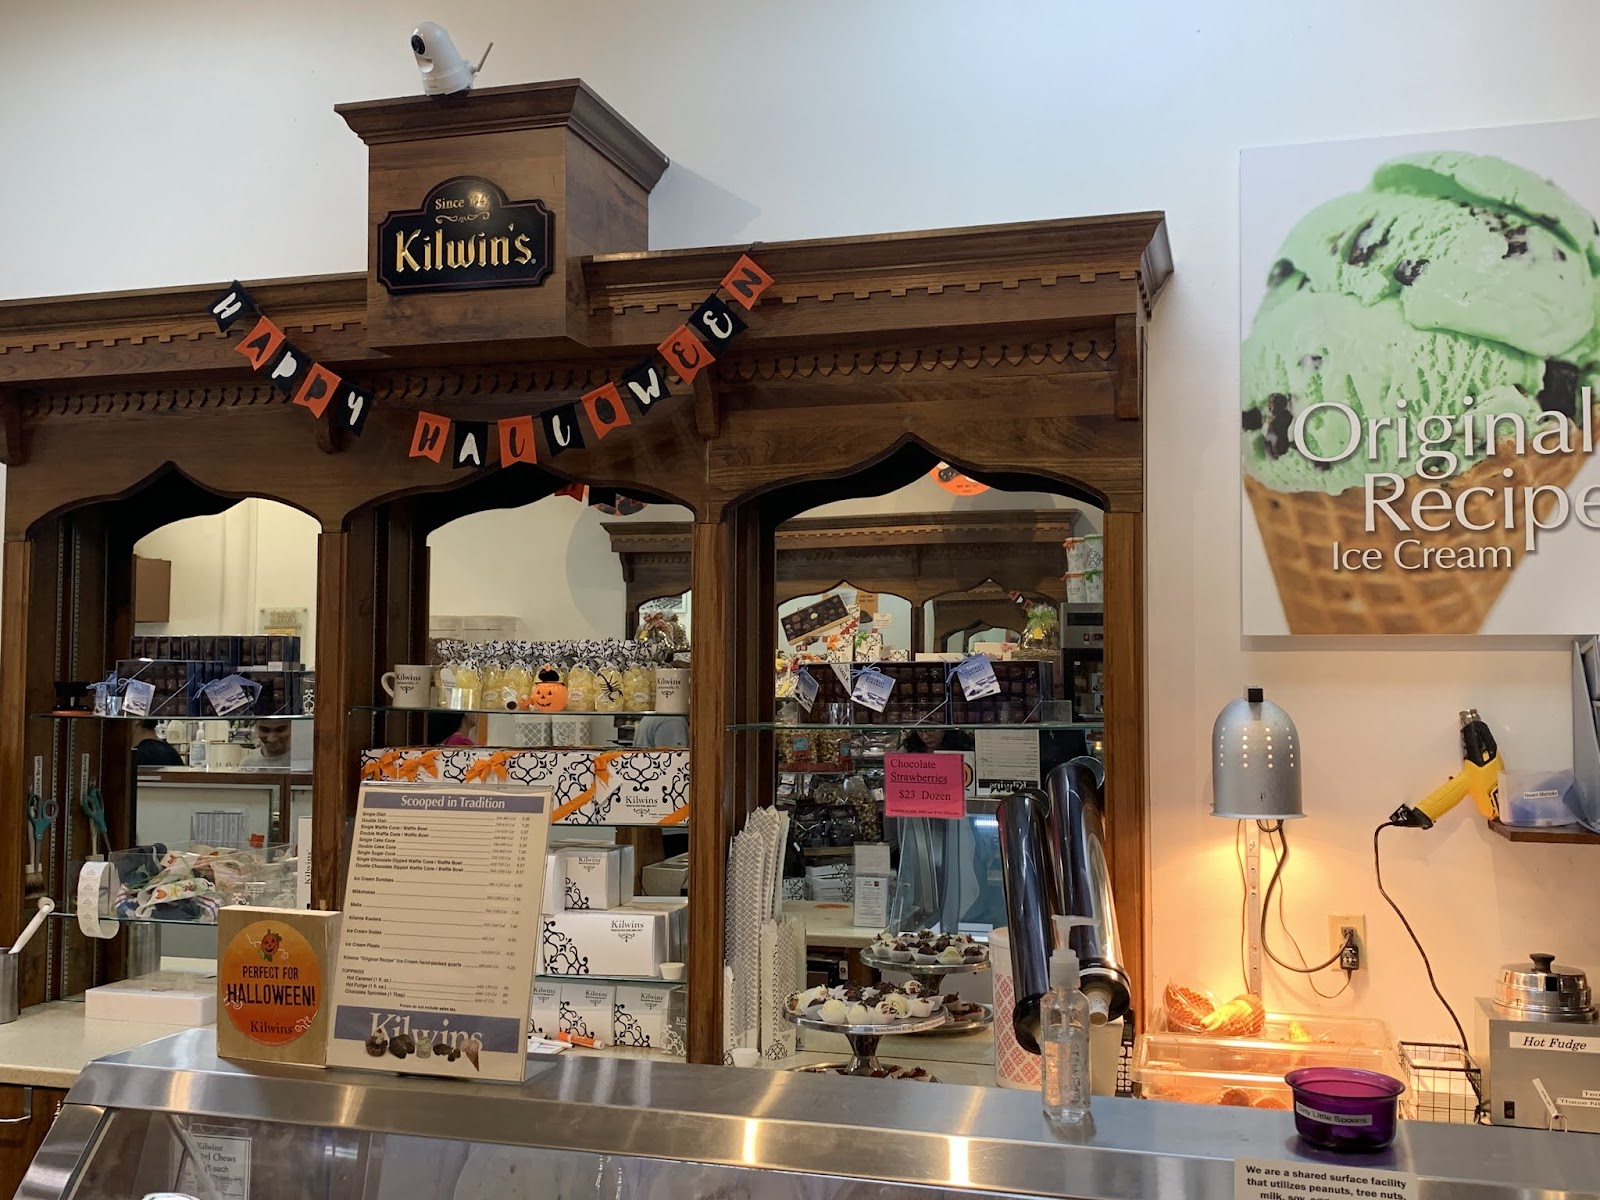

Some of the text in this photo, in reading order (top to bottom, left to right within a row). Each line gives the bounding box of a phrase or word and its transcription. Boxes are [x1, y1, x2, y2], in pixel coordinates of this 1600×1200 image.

[435, 198, 465, 210] Since
[396, 222, 532, 273] Kilwin's
[213, 292, 363, 426] HAPPY
[418, 267, 763, 465] HALLOWEEN
[1294, 386, 1593, 480] Original
[1332, 539, 1512, 570] Ice Cream
[890, 758, 936, 769] Chocolate
[890, 771, 948, 783] Strawberries
[401, 795, 505, 810] Scooped in Tradition
[625, 795, 658, 804] Kilwins
[898, 789, 951, 801] $23 Dozen
[304, 852, 312, 885] Kilwins
[611, 920, 644, 929] Kilwins
[242, 966, 299, 980] PERFECT FOR
[227, 983, 315, 1006] HALLOWEEN!
[533, 986, 556, 994] Kilwins
[585, 989, 608, 997] Kilwins
[640, 992, 664, 1001] Kilwins
[250, 1021, 293, 1035] Kilwins
[369, 1012, 483, 1053] Kilwins
[1522, 1036, 1587, 1052] Hot Fudge
[1297, 1105, 1368, 1124] Dirty Little Spoons
[213, 1153, 236, 1162] Chews
[1245, 1165, 1262, 1174] We
[1292, 1170, 1327, 1180] shared
[1329, 1173, 1369, 1184] surface
[1371, 1177, 1407, 1189] facility
[1247, 1178, 1407, 1200] that utilizes peanuts, tree nuts,
